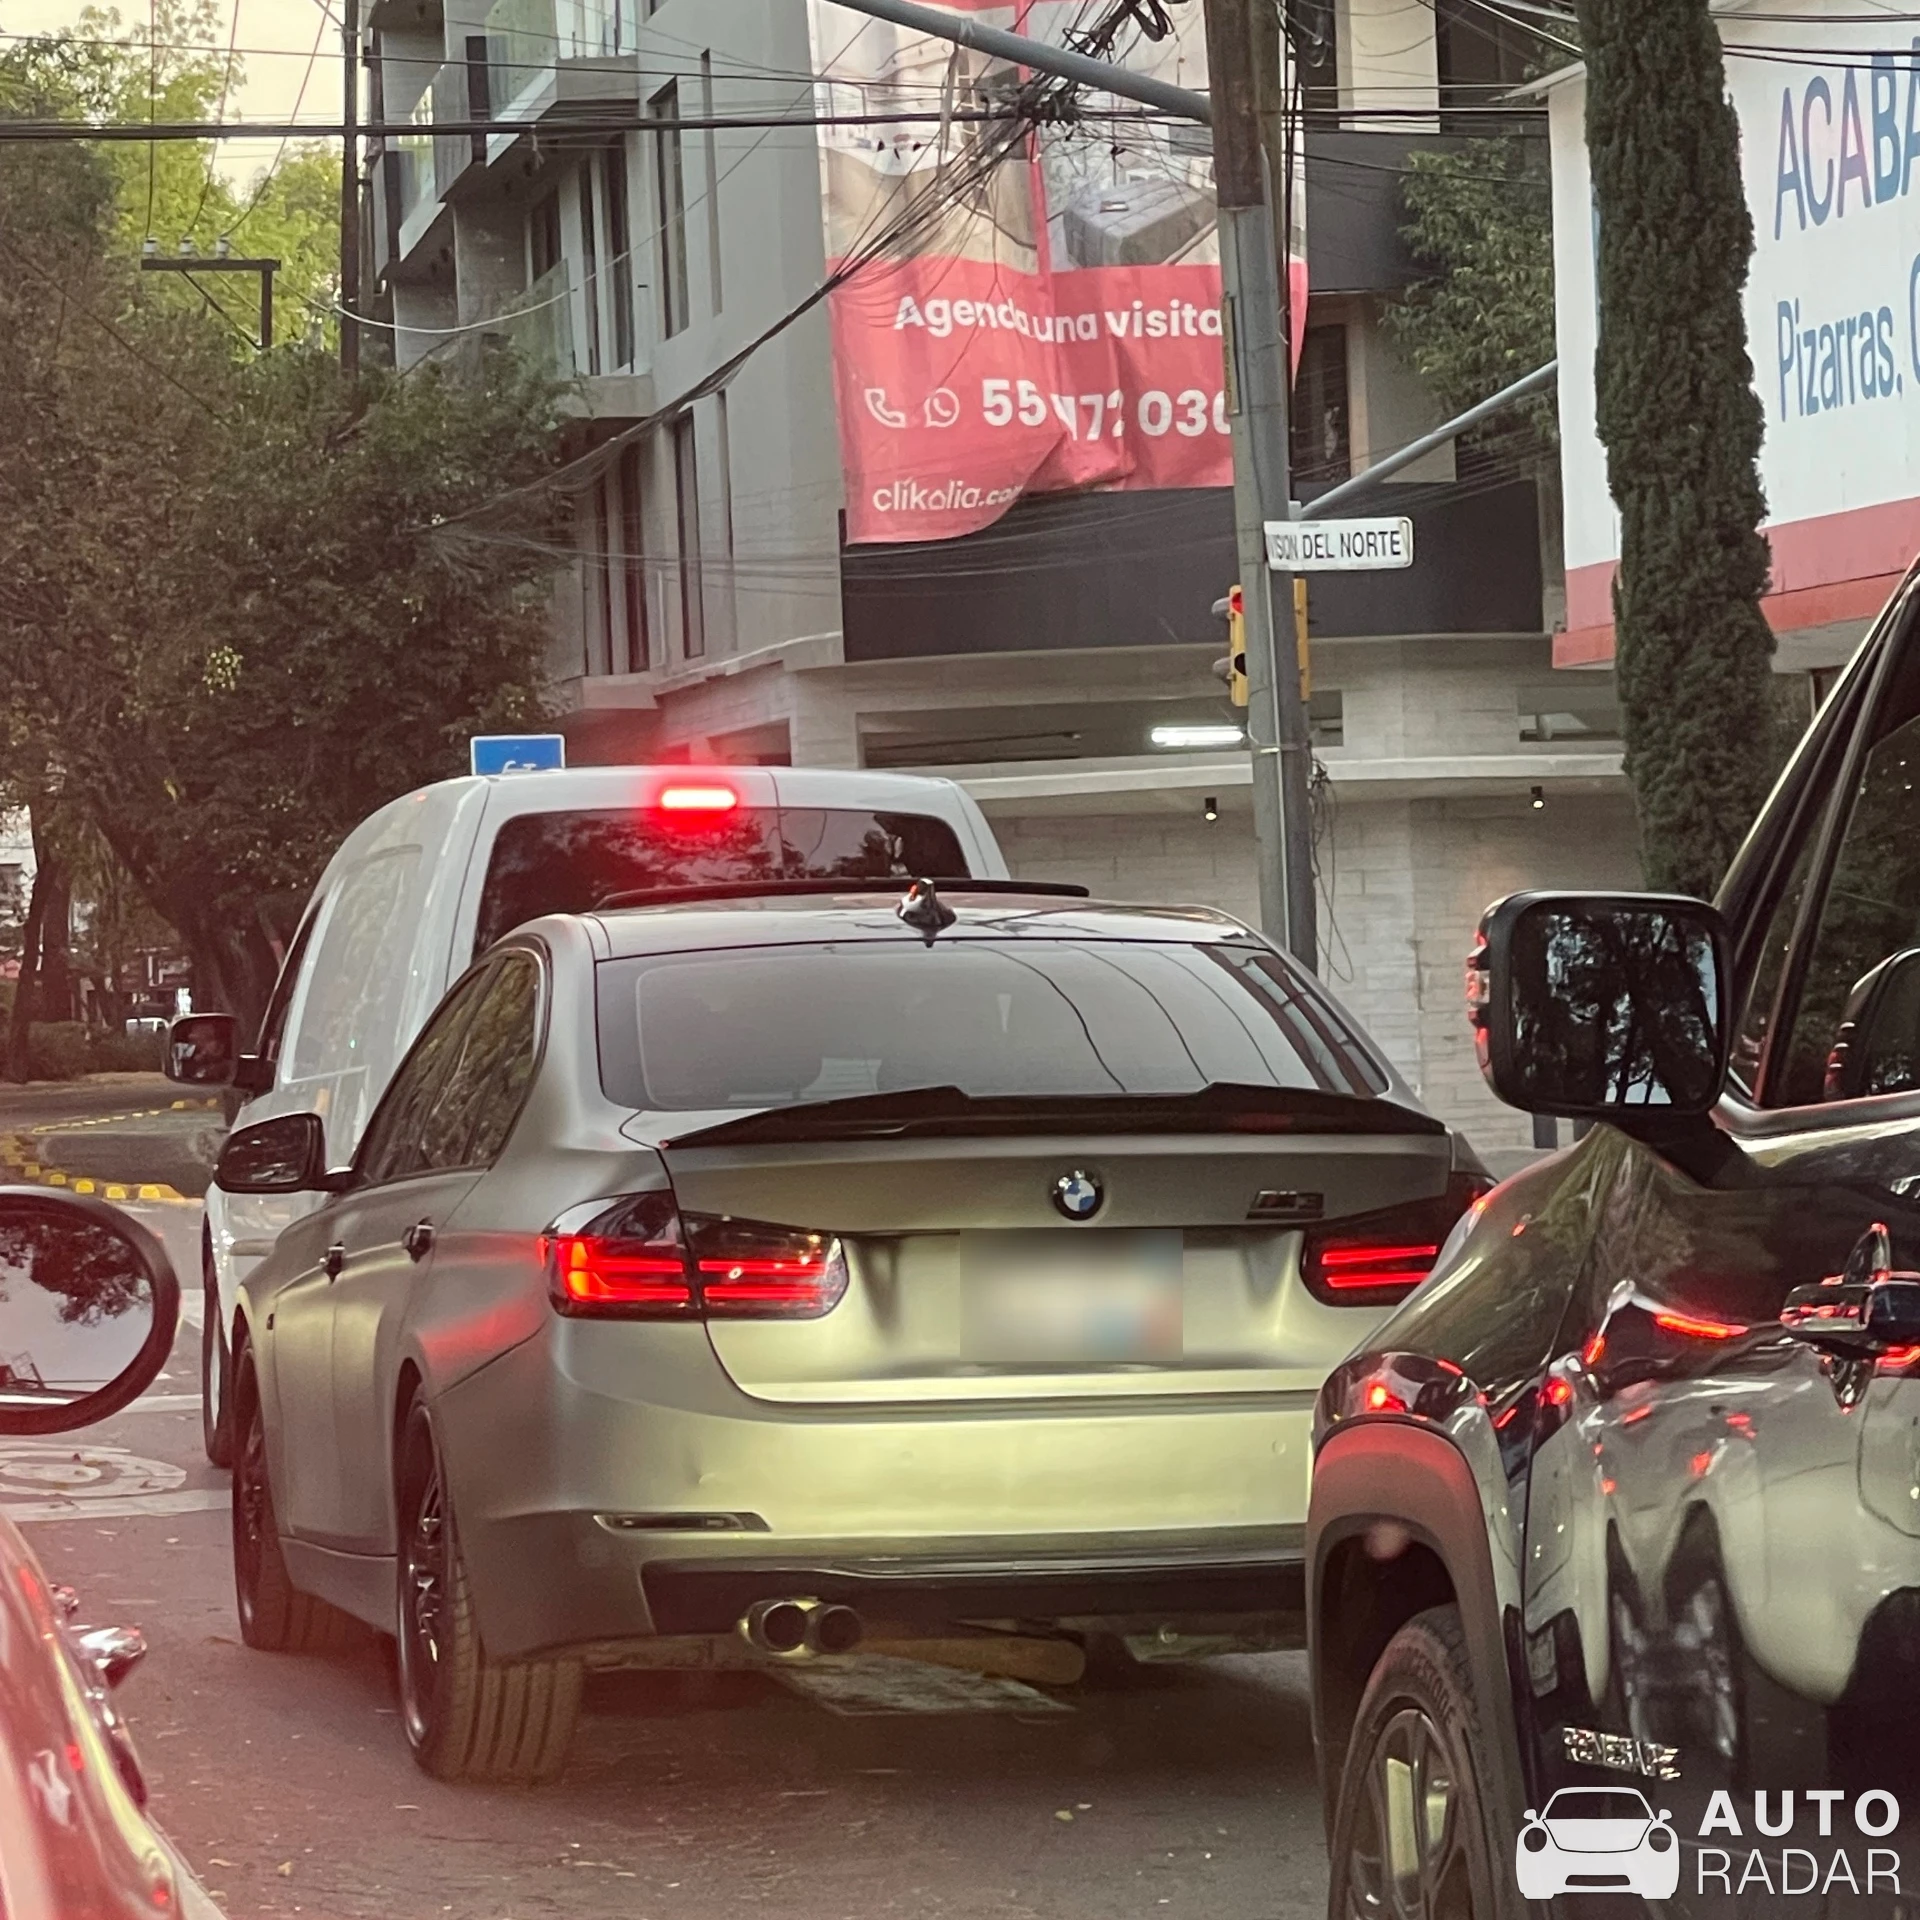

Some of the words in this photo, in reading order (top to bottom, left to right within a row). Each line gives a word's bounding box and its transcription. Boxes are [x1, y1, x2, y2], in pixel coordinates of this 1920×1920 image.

[894, 296, 1032, 338] Agenda
[1032, 314, 1099, 343] una
[1104, 299, 1224, 338] visita
[1302, 534, 1335, 559] DEL
[1340, 530, 1401, 558] NORTE
